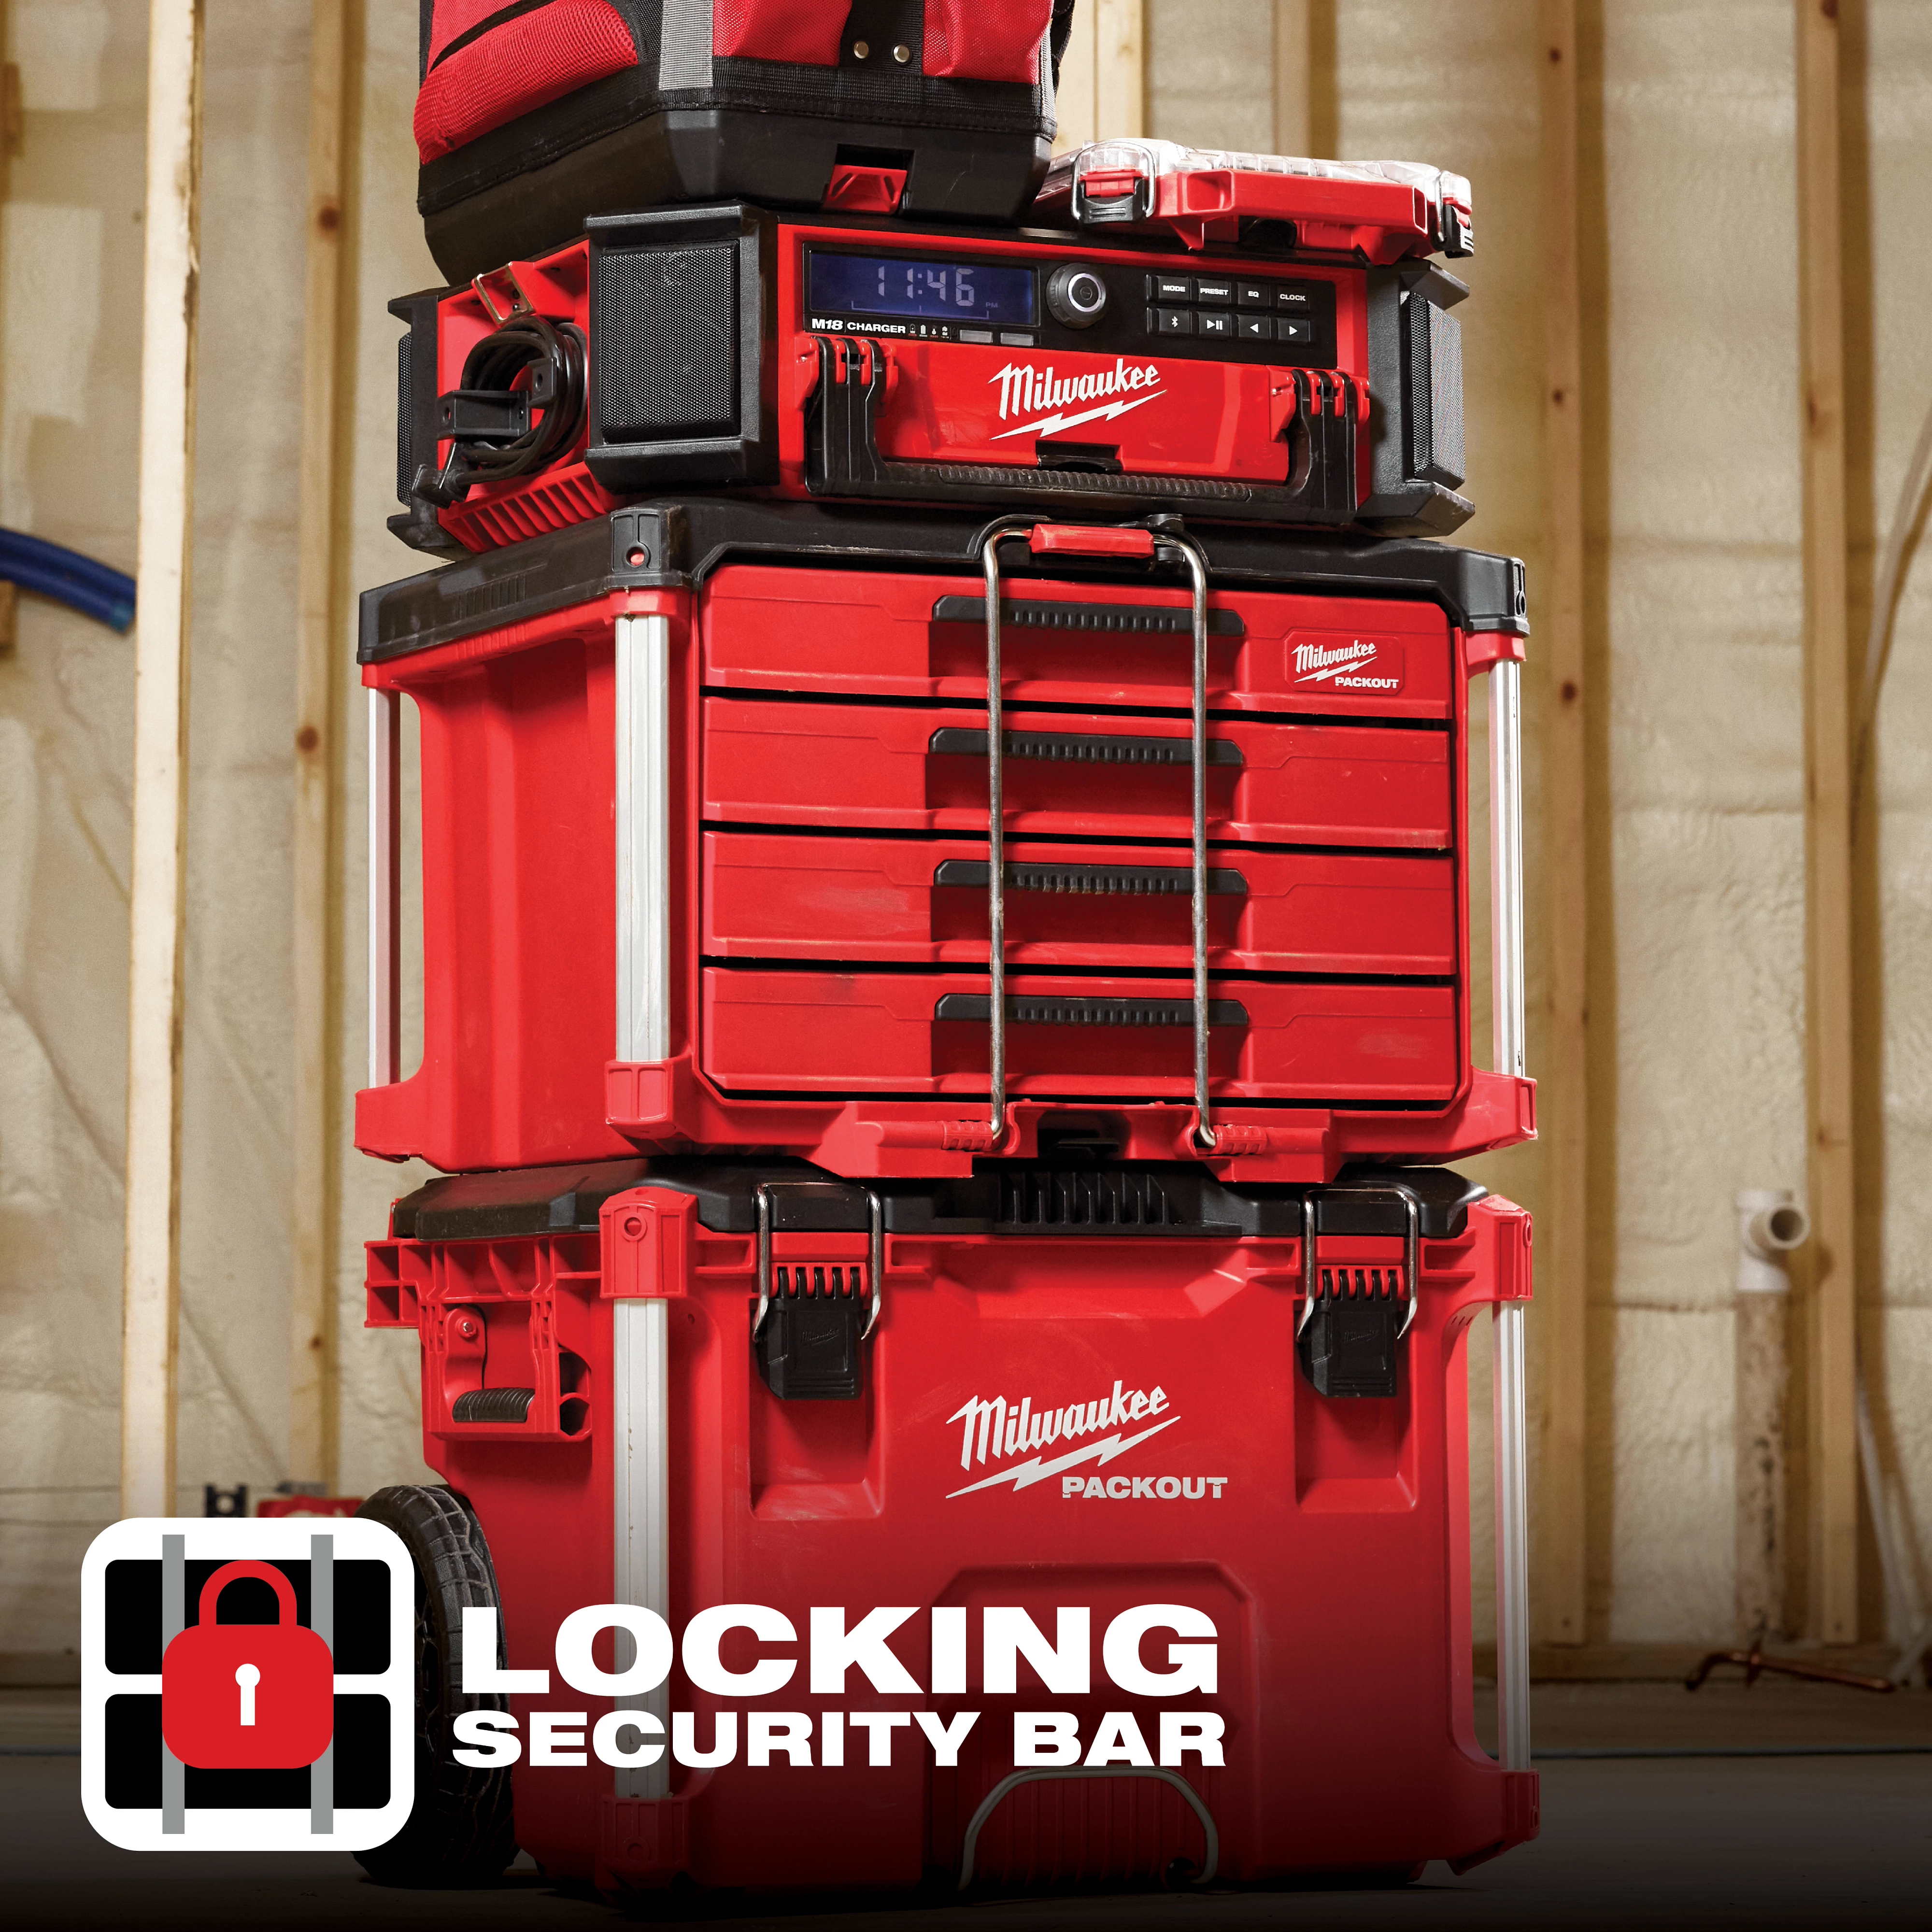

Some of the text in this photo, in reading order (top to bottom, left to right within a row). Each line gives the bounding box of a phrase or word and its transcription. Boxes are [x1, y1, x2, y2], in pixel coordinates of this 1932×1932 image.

[878, 266, 974, 306] 11:46
[1200, 287, 1229, 296] PRESET
[812, 318, 906, 334] M18 CHARGER
[988, 358, 1161, 420] Milwaukee
[1291, 639, 1377, 674] Milwaukee
[1335, 676, 1399, 688] PACKOUT
[946, 1379, 1169, 1471] Milwaukee
[1062, 1476, 1228, 1499] PACKOUT
